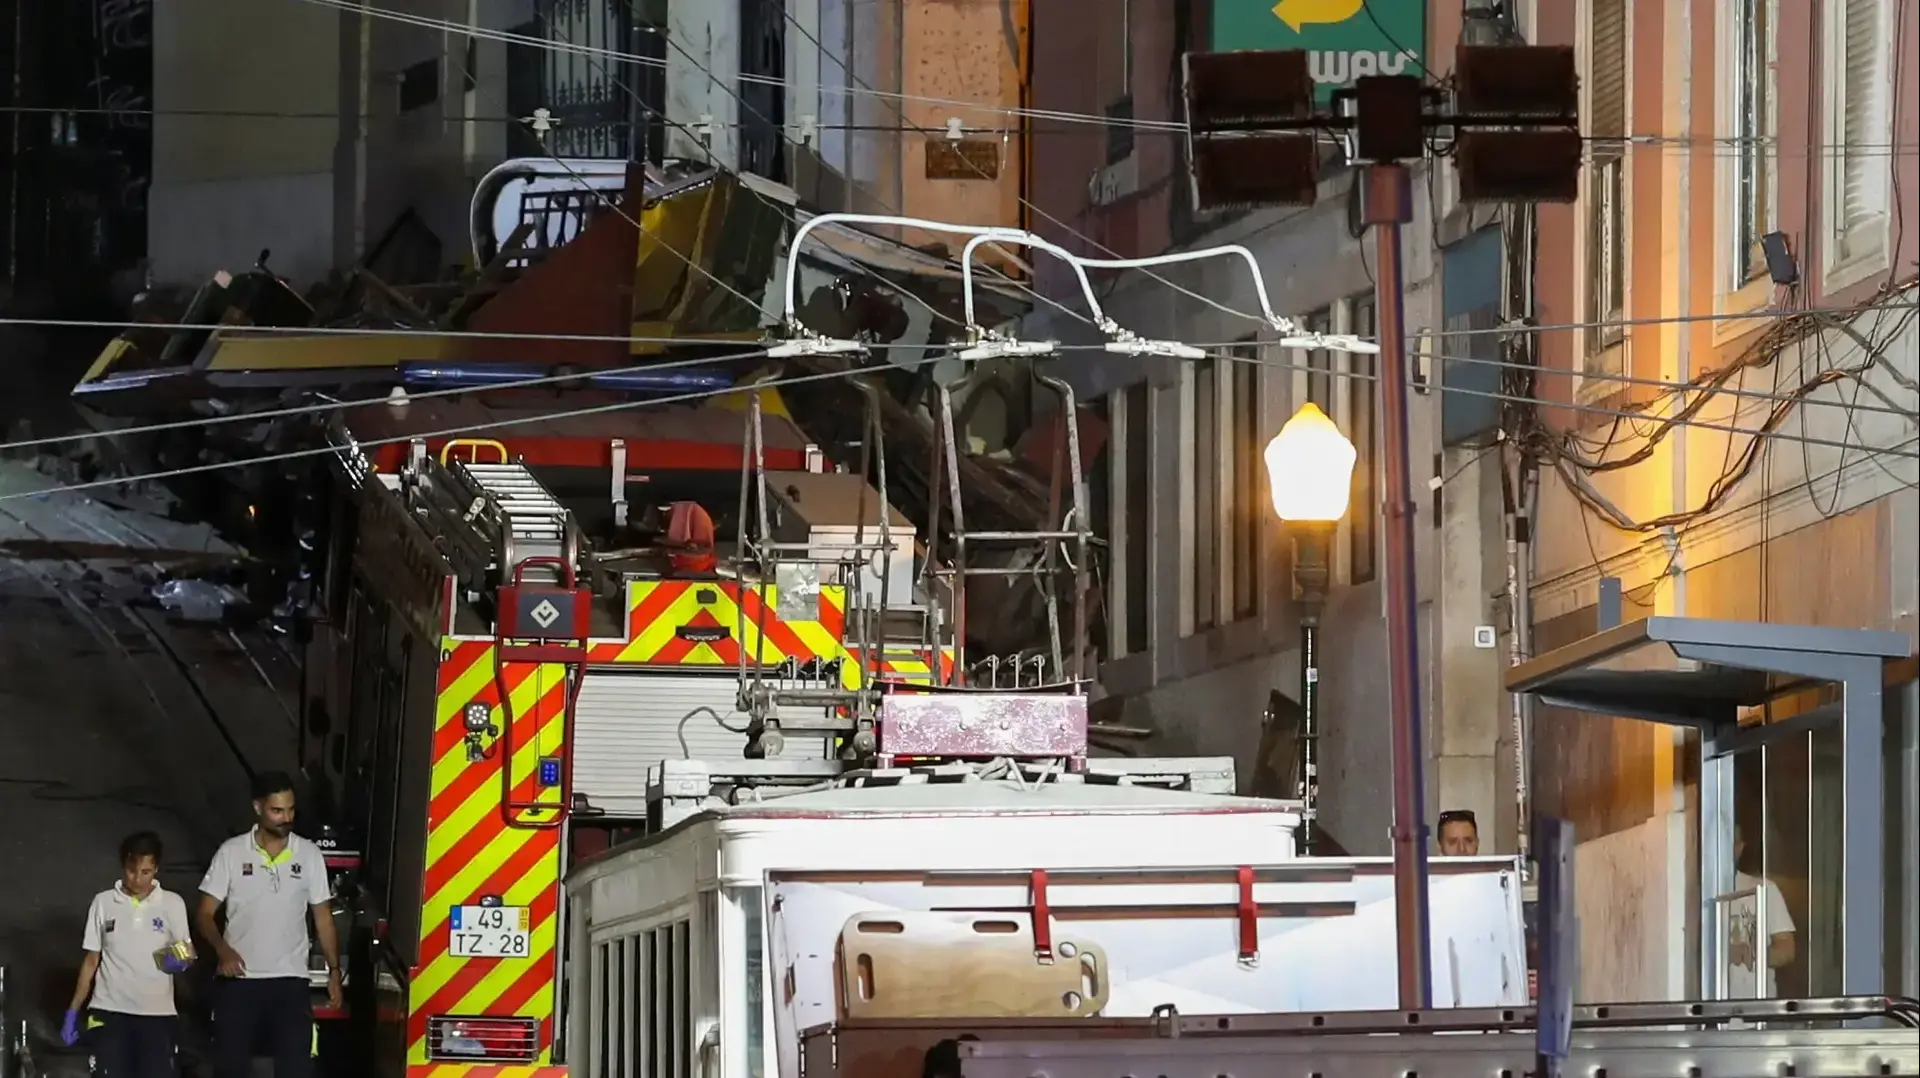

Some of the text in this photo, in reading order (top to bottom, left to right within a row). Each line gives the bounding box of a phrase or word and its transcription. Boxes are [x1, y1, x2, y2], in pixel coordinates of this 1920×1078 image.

[1232, 48, 1418, 85] WAY
[478, 909, 503, 929] 49
[456, 933, 525, 954] TZ 28
